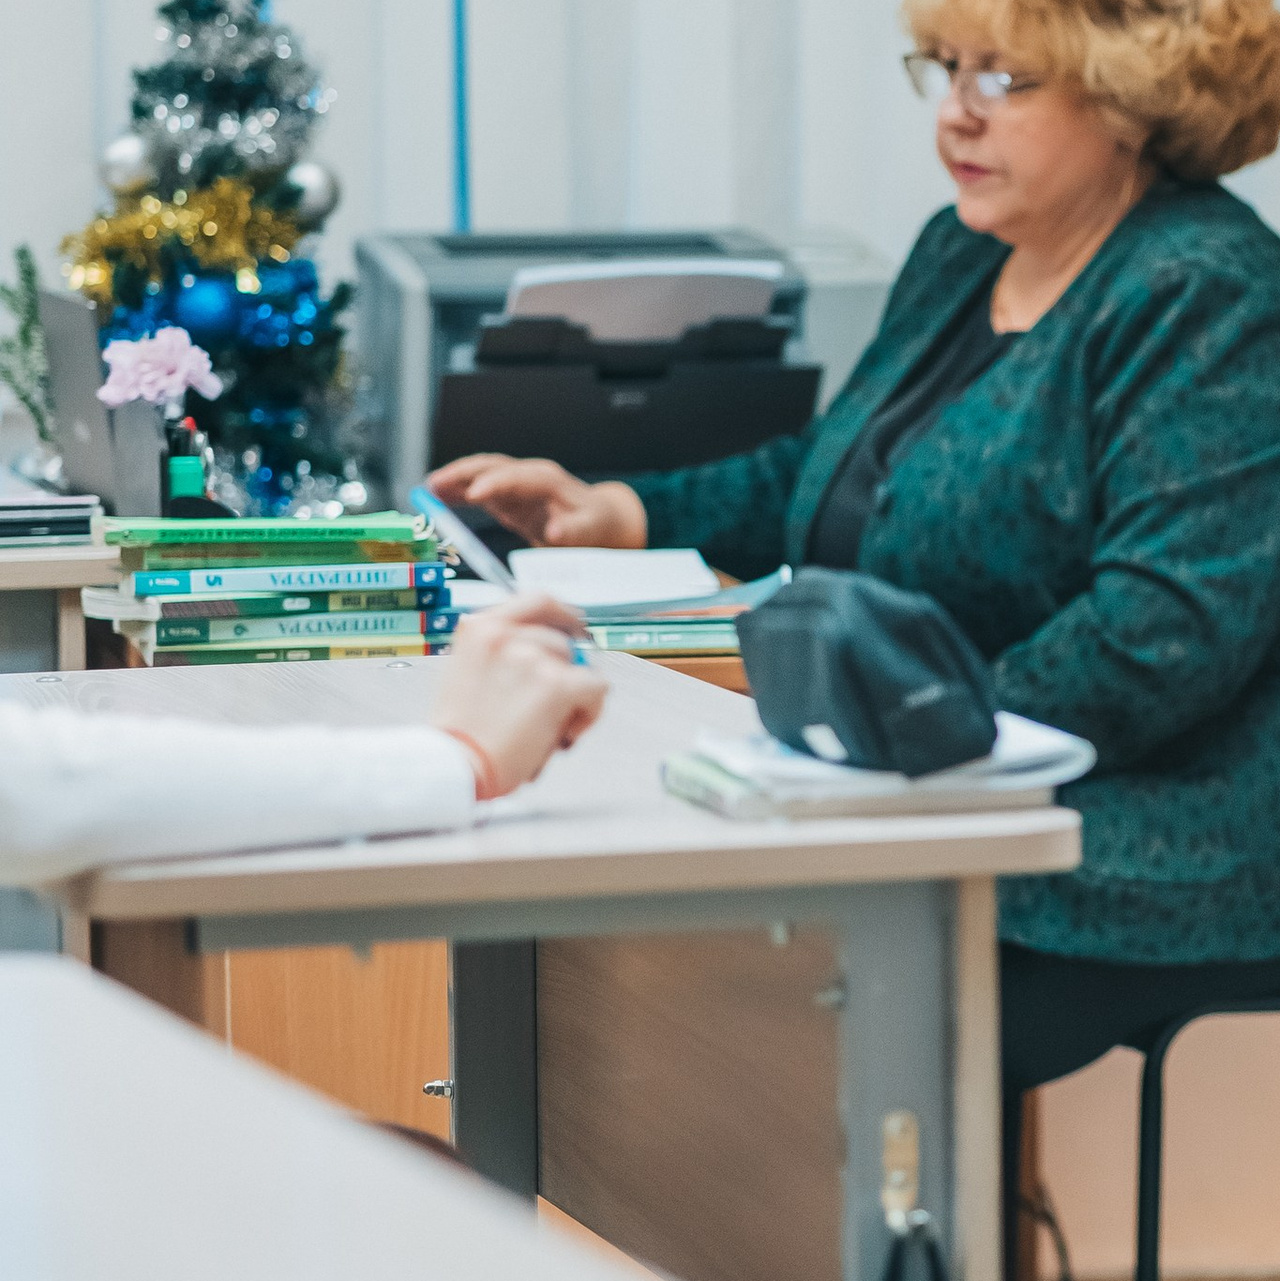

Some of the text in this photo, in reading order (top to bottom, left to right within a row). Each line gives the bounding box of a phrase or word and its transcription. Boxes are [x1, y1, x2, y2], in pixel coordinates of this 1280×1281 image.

[206, 575, 222, 586] 5
[270, 571, 396, 586] ЛИТЕРАТУРА
[278, 616, 403, 634] ЛИТЕРАТУРА
